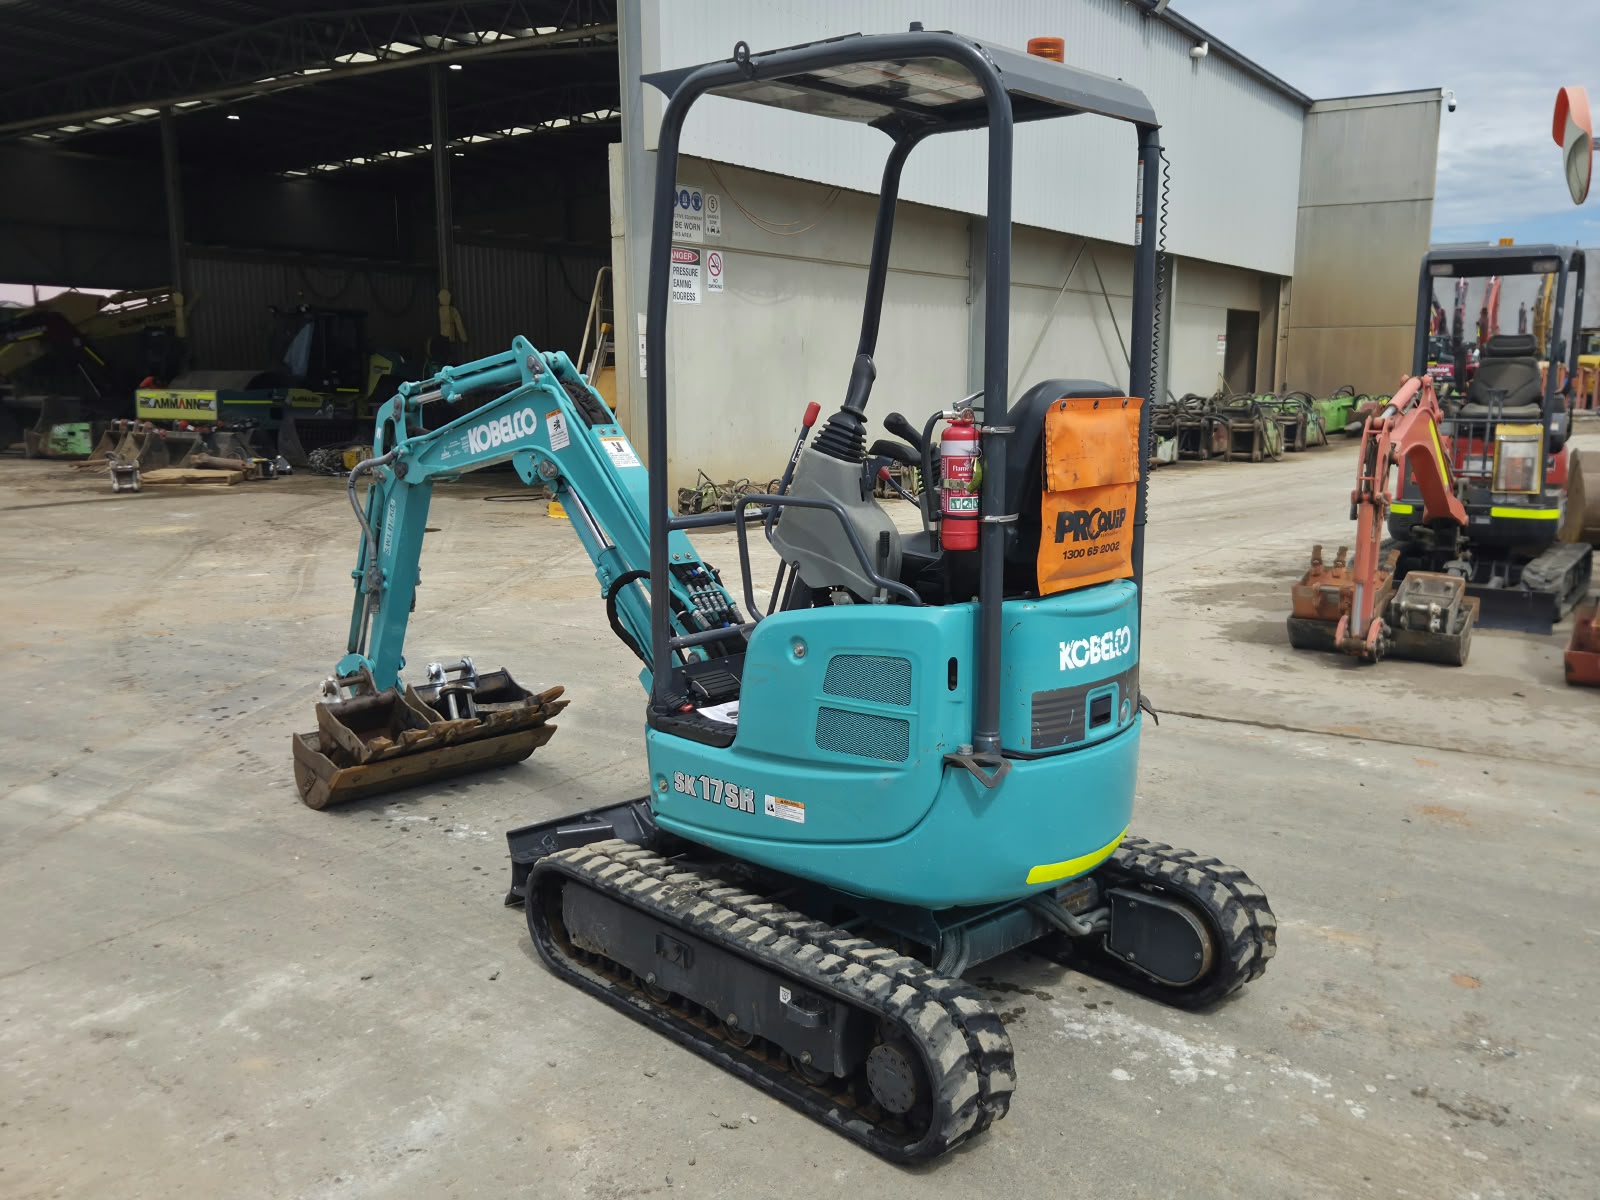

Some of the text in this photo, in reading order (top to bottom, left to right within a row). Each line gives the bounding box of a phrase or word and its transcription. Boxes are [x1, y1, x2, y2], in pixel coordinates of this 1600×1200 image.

[674, 221, 701, 231] BE WORN
[672, 266, 698, 277] PRESSURE
[467, 407, 538, 455] KOBELCO
[1063, 541, 1120, 560] 1300 65 2002
[1059, 625, 1131, 671] KOBELCO
